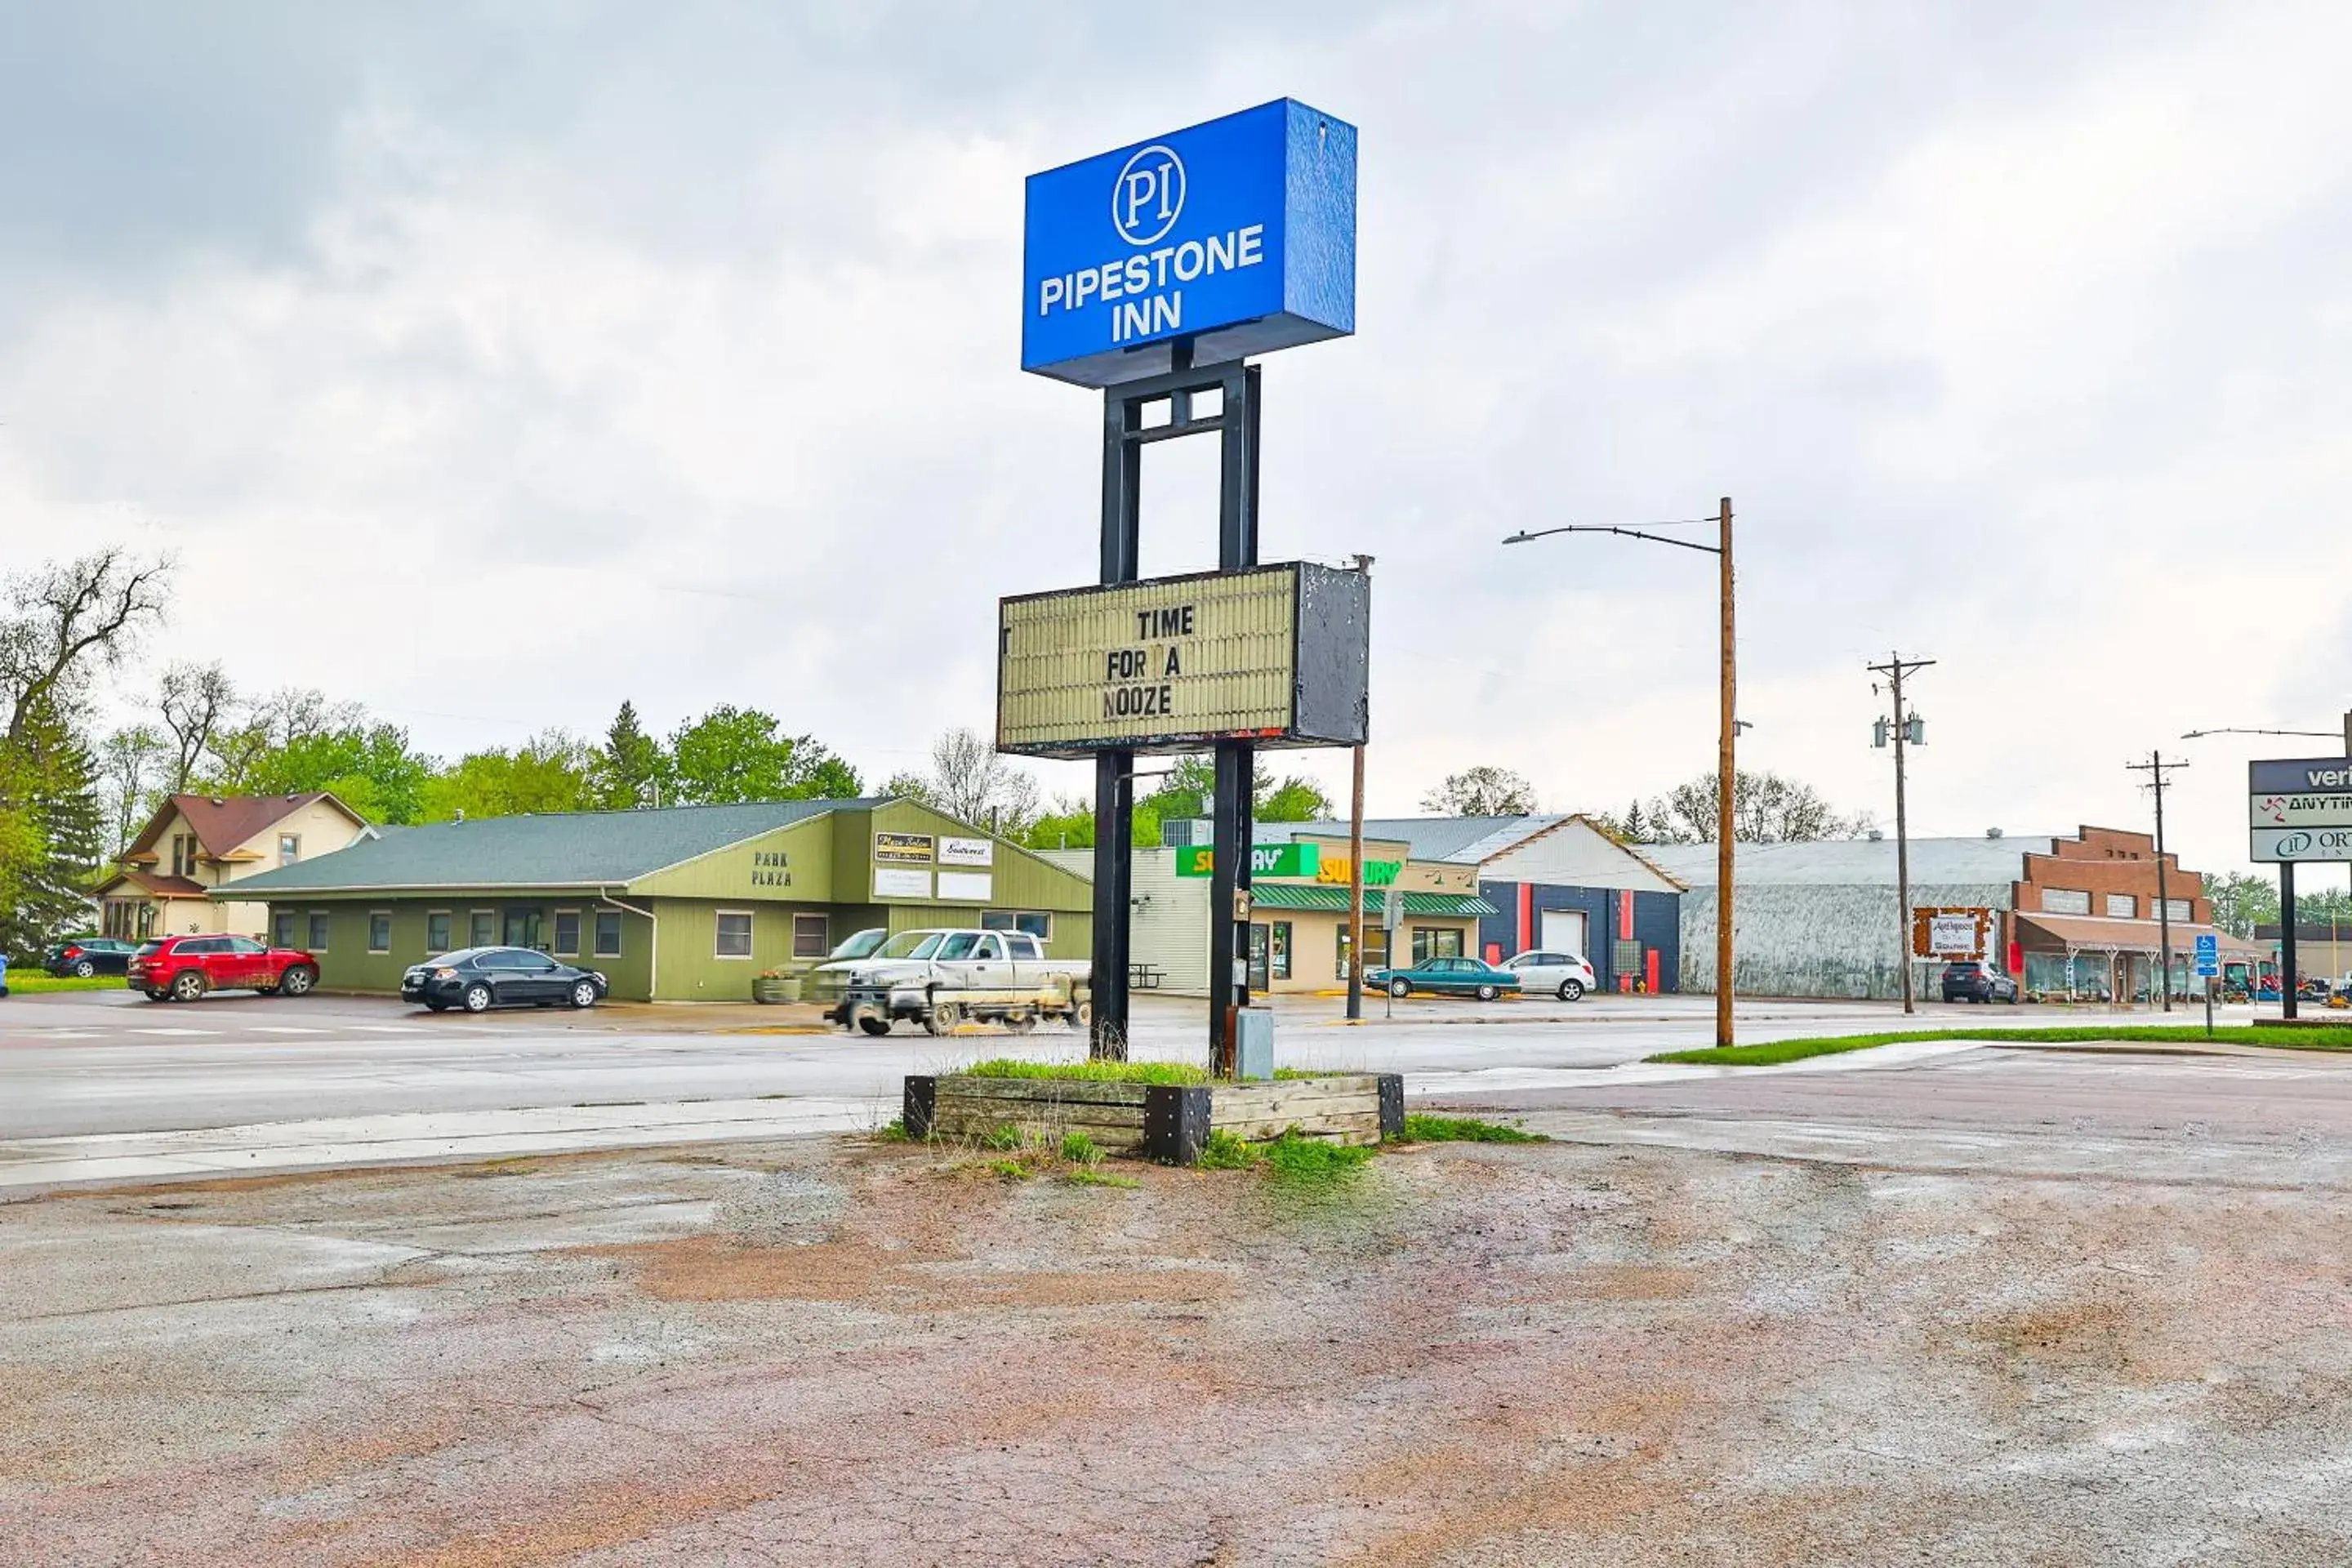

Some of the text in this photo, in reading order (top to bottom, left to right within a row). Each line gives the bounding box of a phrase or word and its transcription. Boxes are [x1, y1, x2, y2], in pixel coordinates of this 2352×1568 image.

[1125, 163, 1173, 228] PI
[1040, 224, 1263, 316] PIPESTONE
[1112, 291, 1181, 342] INN
[1138, 605, 1192, 640] TIME
[1107, 647, 1180, 680] FOR A
[1103, 685, 1171, 718] NOOZE
[755, 852, 787, 867] PARK
[752, 871, 791, 887] PLAZA
